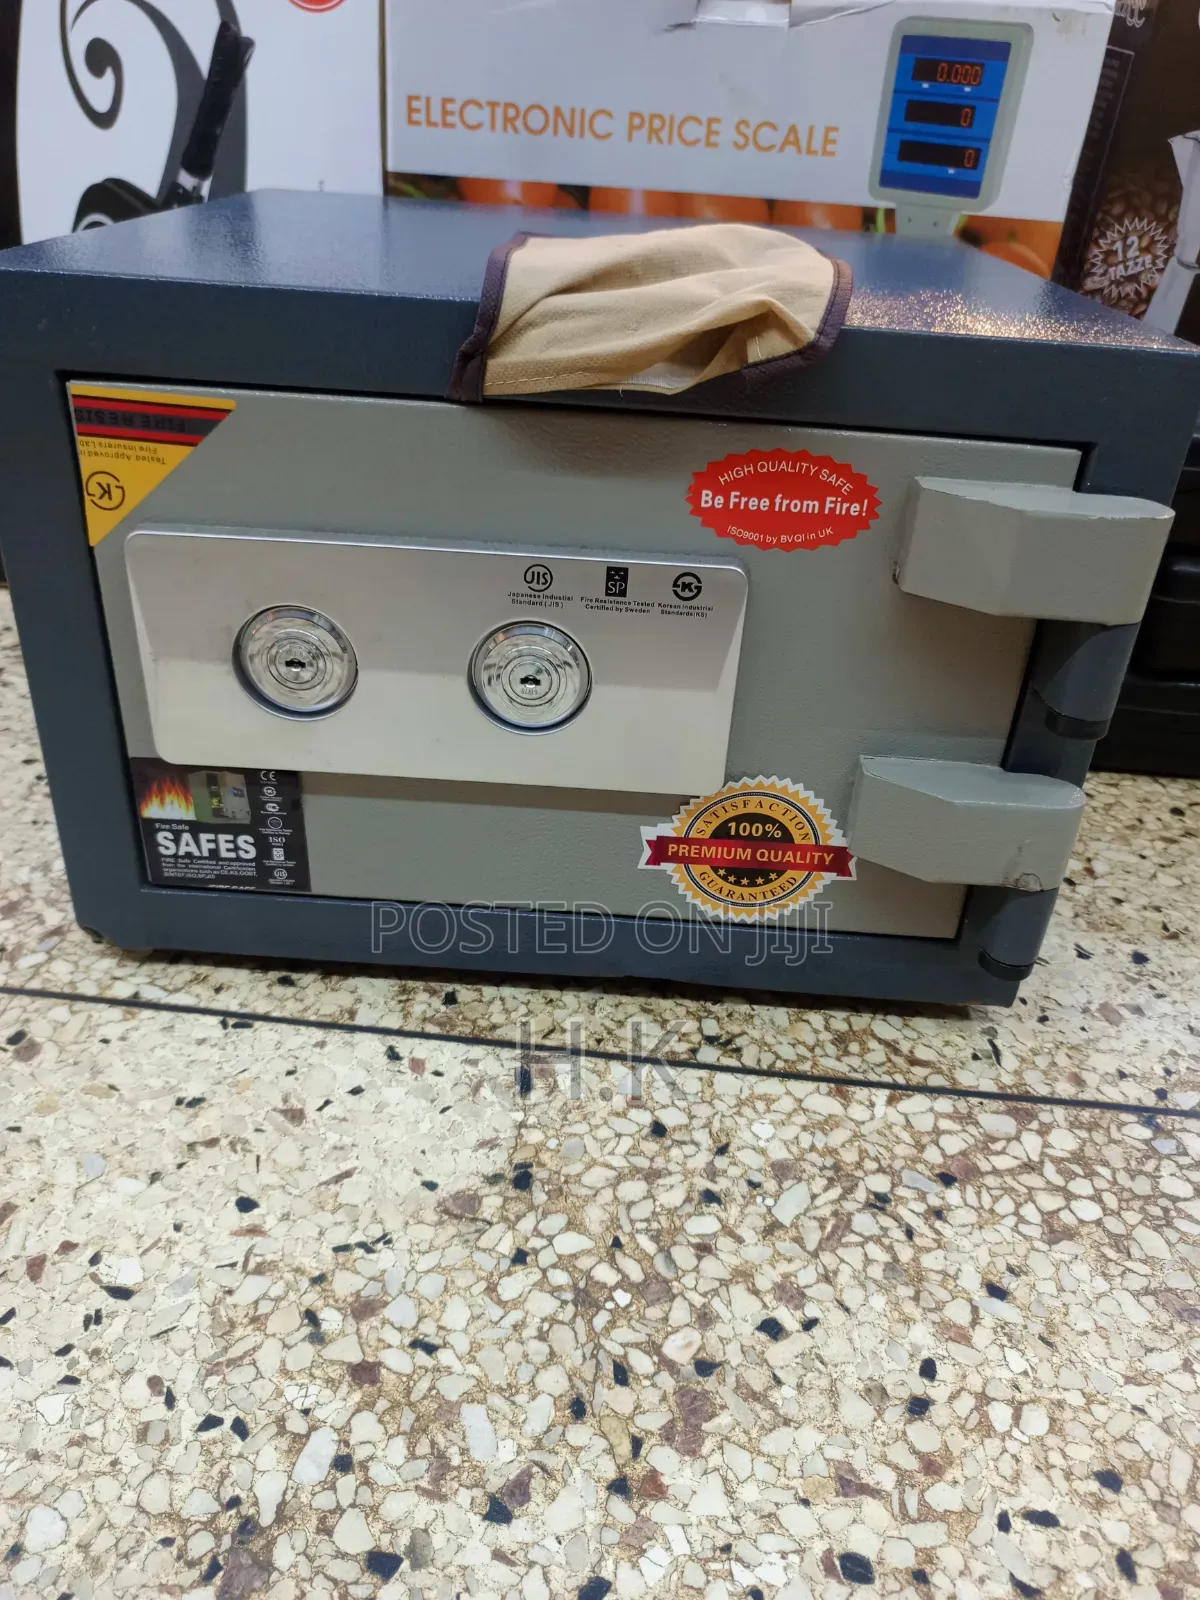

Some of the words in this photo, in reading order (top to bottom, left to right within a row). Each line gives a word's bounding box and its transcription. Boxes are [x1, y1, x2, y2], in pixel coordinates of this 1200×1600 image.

[935, 62, 983, 85] 0.000
[406, 95, 614, 141] ELECTRONIC
[627, 112, 722, 149] PRICE
[732, 119, 840, 157] SCALE
[960, 107, 972, 127] 0
[963, 149, 976, 168] 0
[1112, 235, 1141, 262] 12
[1107, 255, 1153, 280] TAZZE
[141, 414, 186, 434] FIRE
[87, 450, 132, 461] Approved
[135, 455, 166, 465] Tested
[139, 446, 158, 455] Fire
[718, 463, 754, 486] HIGH
[757, 460, 819, 477] QUALITY
[819, 469, 854, 496] SAFE
[700, 489, 725, 509] Be
[729, 491, 770, 512] Free
[774, 493, 820, 514] from
[824, 496, 869, 517] Fire!
[726, 524, 764, 543] ISO9001
[766, 534, 778, 545] by
[806, 532, 816, 541] in
[818, 526, 834, 538] UK
[507, 591, 541, 600] Japanese
[607, 581, 626, 595] SP
[511, 598, 543, 607] Standard
[585, 603, 614, 611] Certified
[594, 597, 632, 606] Resistance
[633, 600, 655, 608] Tested
[657, 602, 681, 610] Korean
[682, 604, 714, 612] Industrial
[155, 822, 171, 830] Fire
[172, 823, 190, 831] Safe
[696, 799, 811, 842] SATISFACTION
[727, 821, 782, 839] 100%
[156, 830, 257, 860] SAFES
[667, 843, 752, 862] PREMIUM
[756, 848, 835, 866] QUALITY
[698, 870, 798, 901] GUARANTEED
